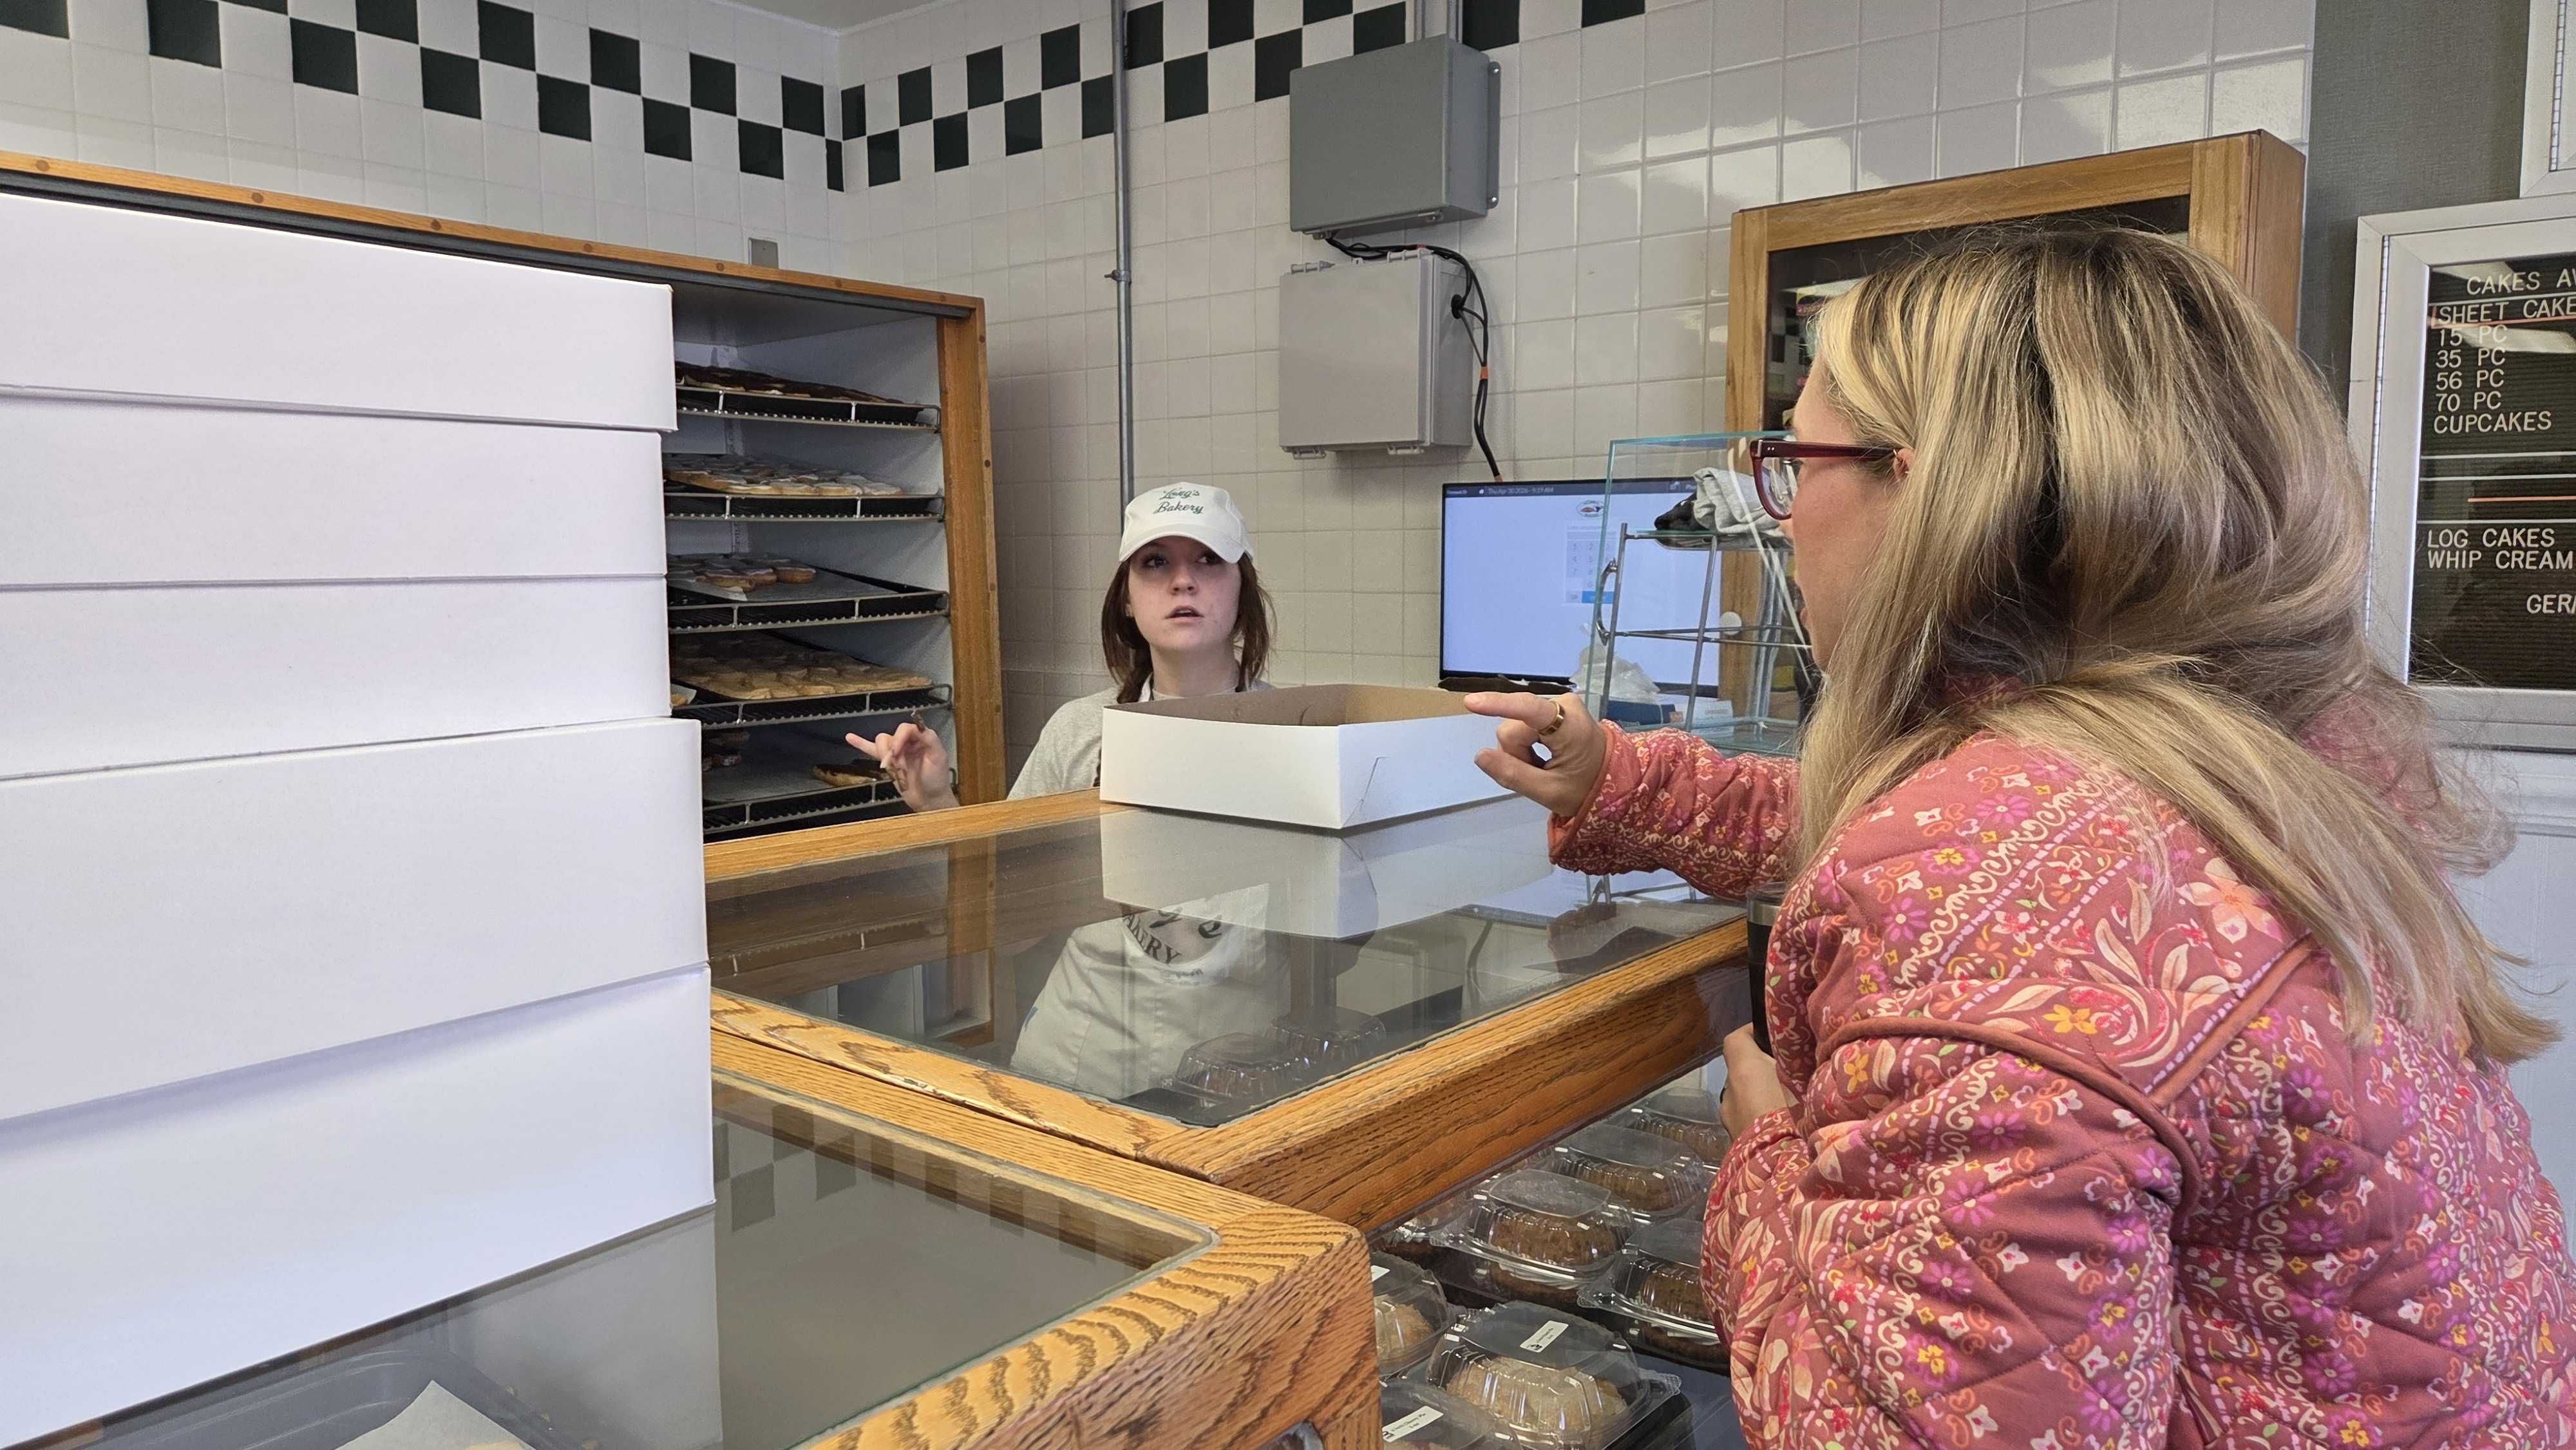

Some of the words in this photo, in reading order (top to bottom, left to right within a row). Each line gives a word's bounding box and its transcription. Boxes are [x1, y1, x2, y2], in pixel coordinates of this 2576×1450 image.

[2467, 272, 2540, 295] CAKES
[2439, 301, 2509, 324] SHEET
[2523, 296, 2576, 319] CAKE
[2439, 328, 2463, 347] 15
[2479, 325, 2508, 344] PC
[2435, 349, 2462, 368] 35
[2477, 346, 2506, 366] PC
[2436, 371, 2463, 391] 56
[2476, 368, 2505, 388] PC
[2435, 393, 2461, 412] 70
[2473, 391, 2502, 410] PC
[2433, 411, 2552, 434] CUPCAKES
[1159, 487, 1200, 500] Long's
[1153, 501, 1204, 515] Bakery
[2427, 529, 2468, 548] LOG
[2482, 528, 2555, 547] CAKES
[2428, 550, 2481, 569] WHIP
[2496, 550, 2573, 569] CREAM
